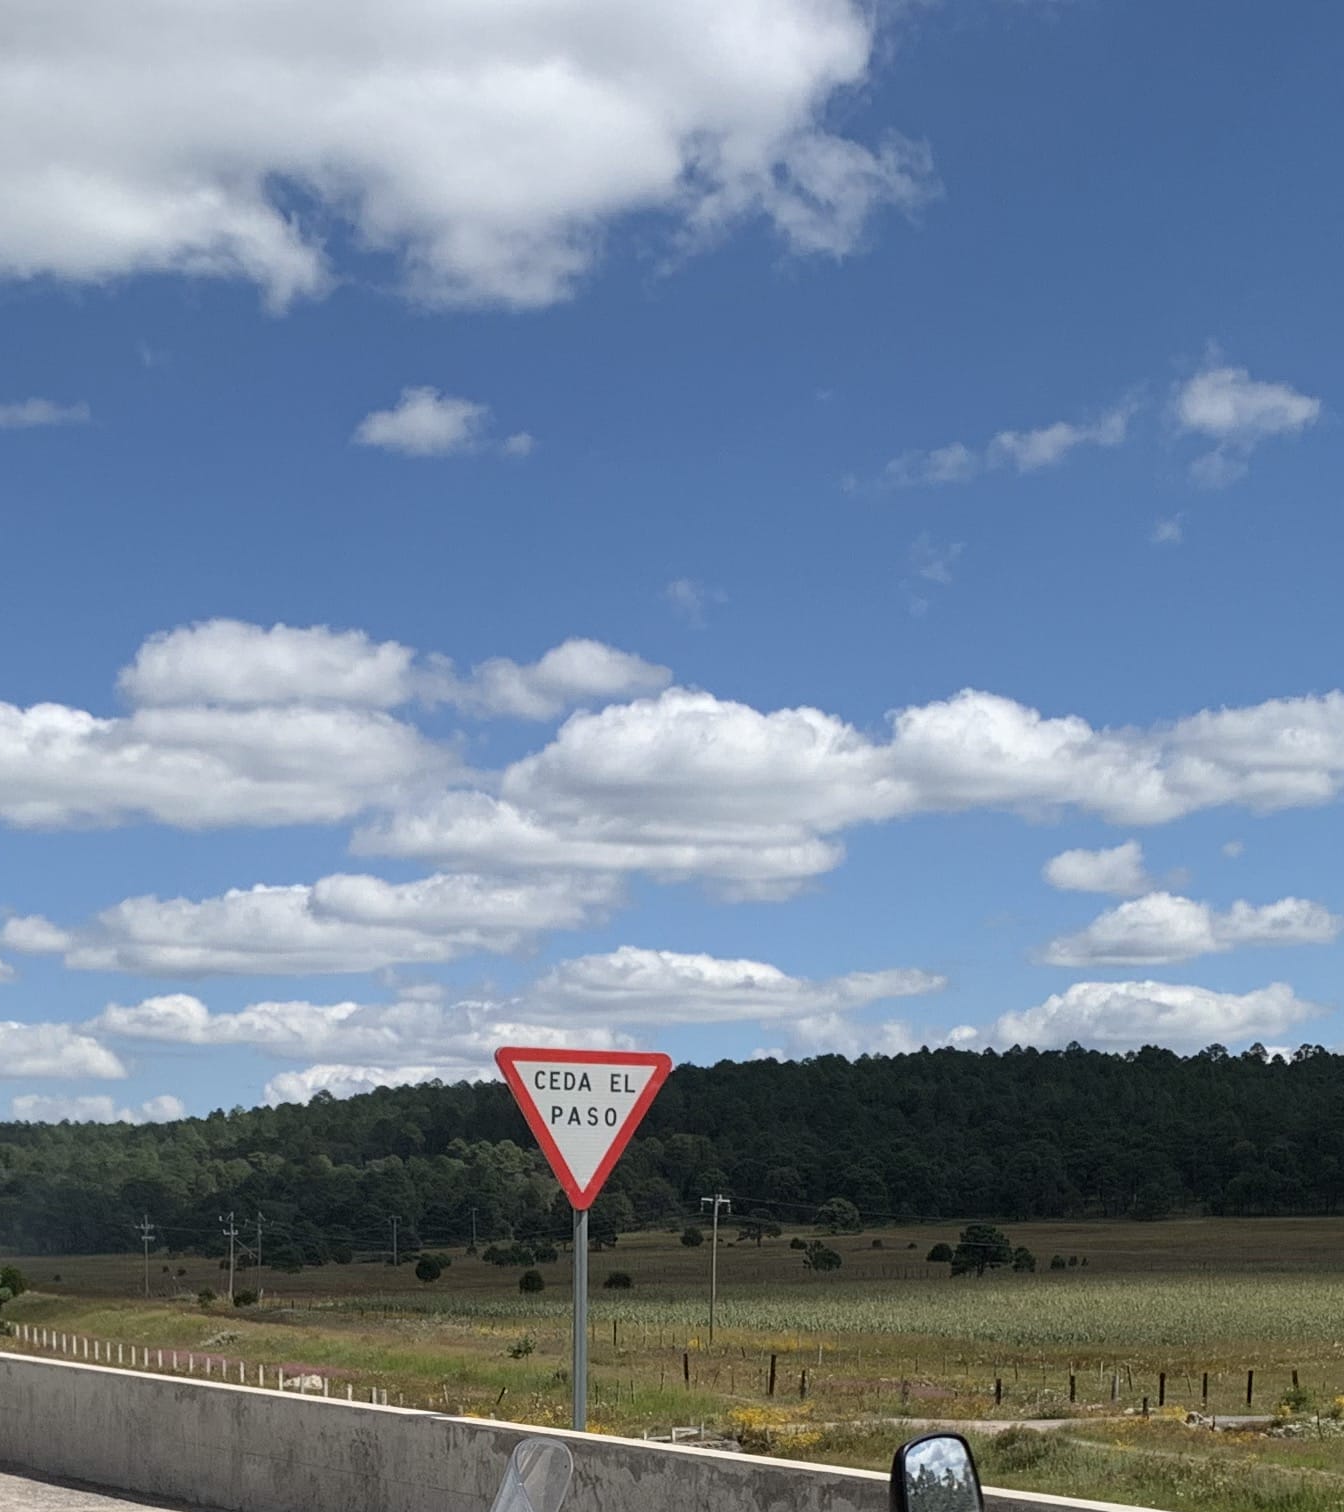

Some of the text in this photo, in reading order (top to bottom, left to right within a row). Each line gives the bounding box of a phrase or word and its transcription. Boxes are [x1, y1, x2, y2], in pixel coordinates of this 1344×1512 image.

[534, 1070, 636, 1094] CEDA EL
[550, 1105, 618, 1127] PASO
